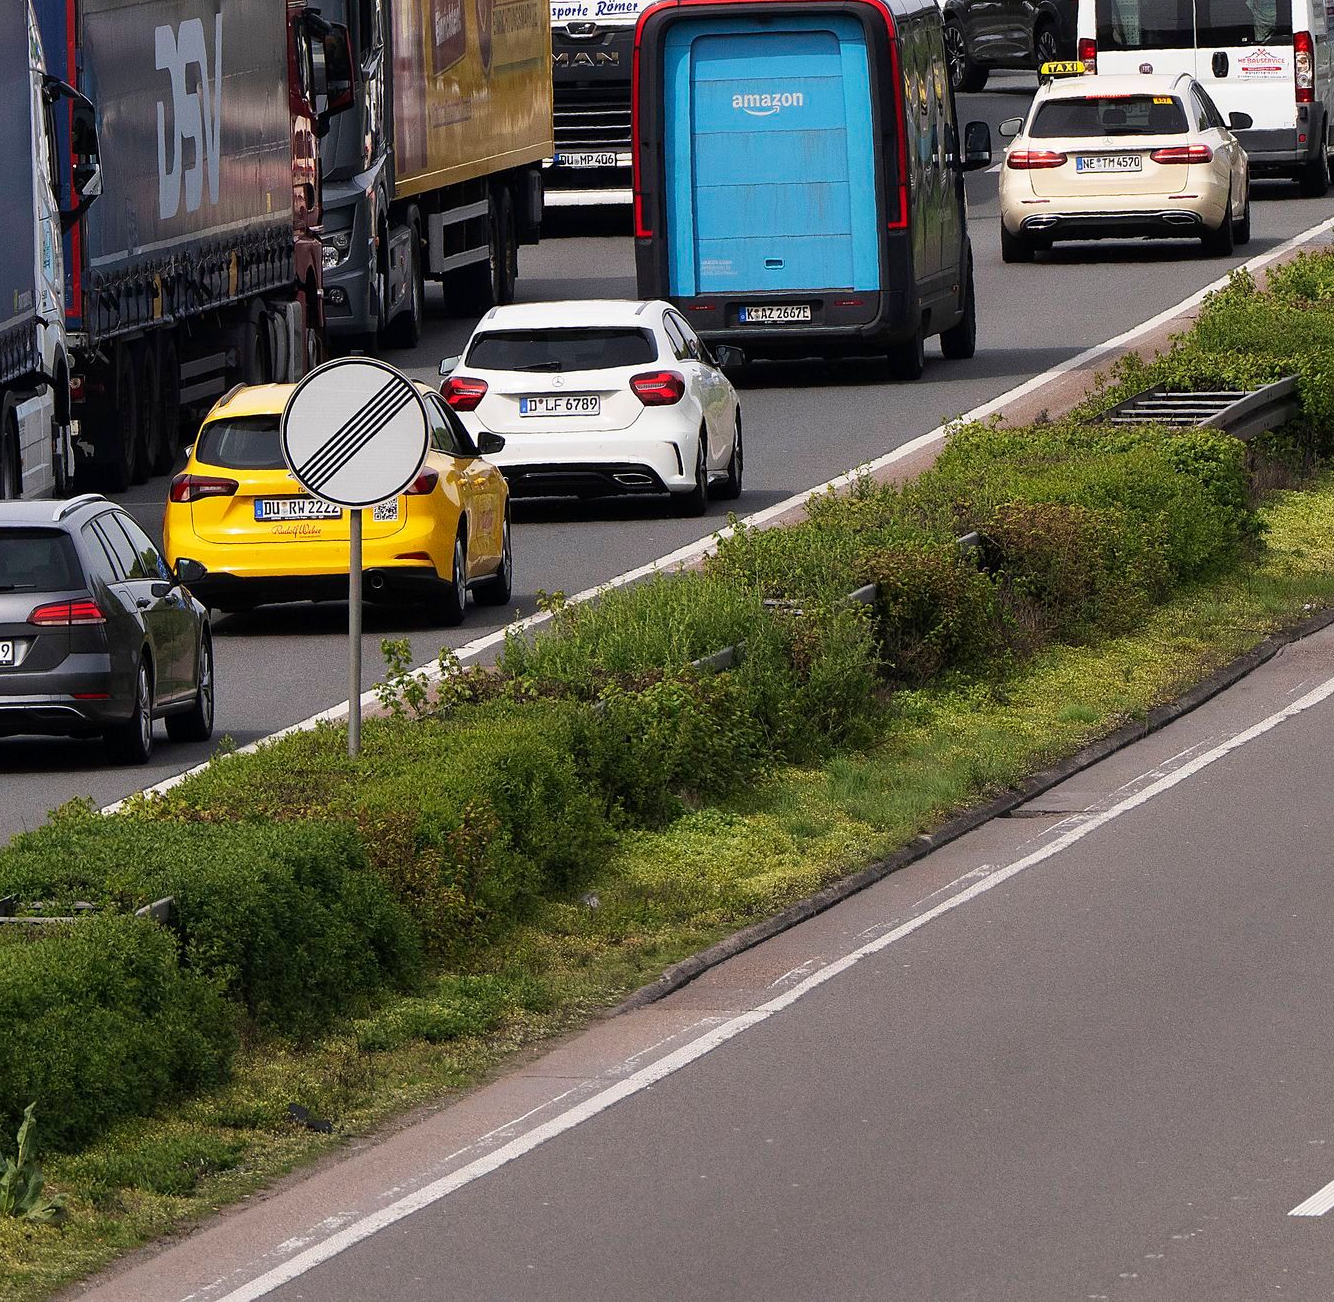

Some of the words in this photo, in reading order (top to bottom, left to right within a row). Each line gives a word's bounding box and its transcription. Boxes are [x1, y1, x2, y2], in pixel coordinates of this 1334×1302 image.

[552, 4, 588, 20] sporte
[595, 0, 639, 16] Römer
[1049, 63, 1078, 73] TAXI
[732, 92, 804, 109] amazon
[154, 12, 222, 221] DSV
[580, 155, 594, 165] MP
[595, 154, 614, 164] 406
[1083, 157, 1095, 169] NE
[1102, 157, 1115, 168] TM
[1116, 156, 1140, 167] 4570
[747, 307, 754, 320] K
[761, 307, 774, 319] AZ
[776, 305, 809, 319] 2667E
[529, 400, 537, 411] D
[546, 399, 562, 411] LF
[565, 397, 597, 410] 6789
[264, 502, 280, 515] DU
[289, 501, 305, 514] RW
